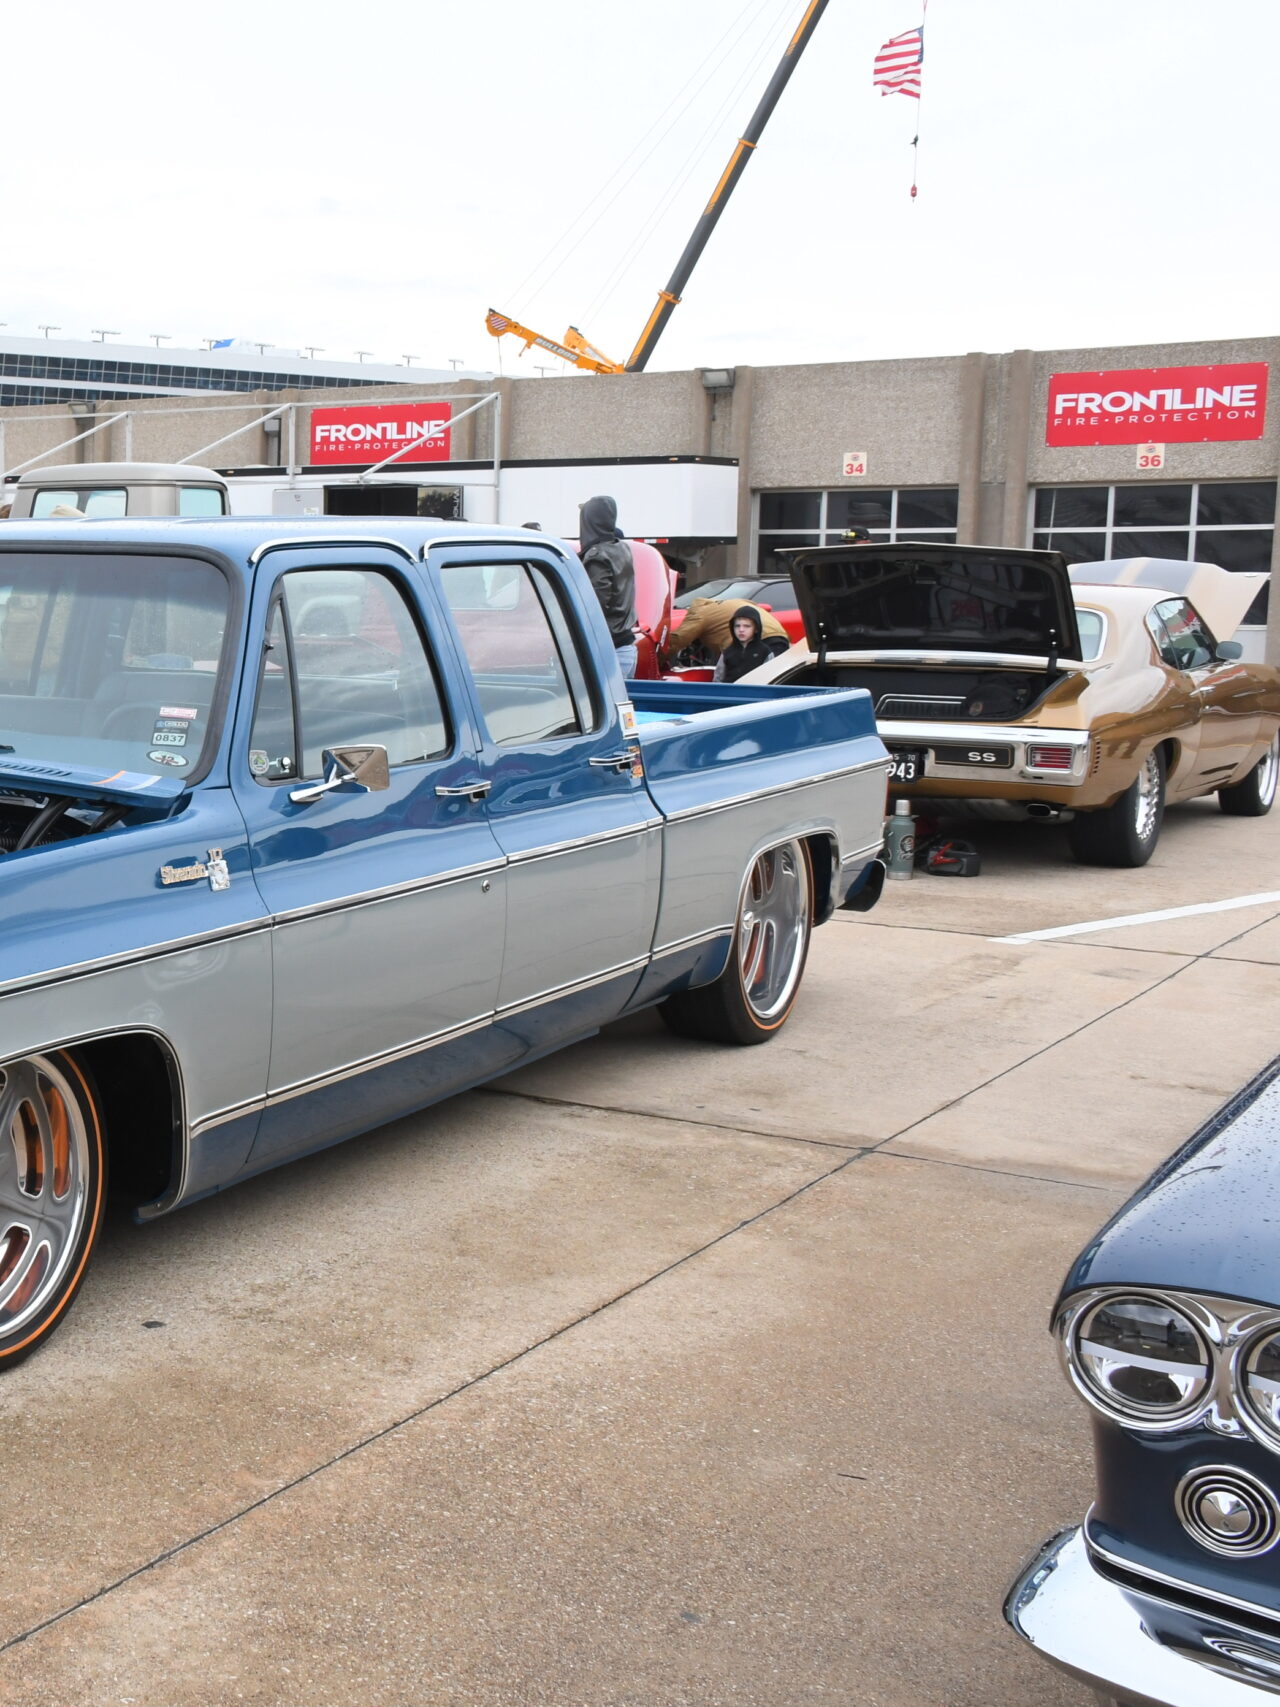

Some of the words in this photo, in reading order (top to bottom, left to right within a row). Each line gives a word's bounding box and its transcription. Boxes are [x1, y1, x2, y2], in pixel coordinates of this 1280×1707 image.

[1055, 384, 1258, 415] FRONTLINE
[1115, 410, 1256, 424] PROTECTION
[315, 420, 445, 442] FRONTLINE
[355, 440, 445, 450] PROTECION
[1139, 455, 1161, 468] 36
[845, 463, 864, 475] 34
[155, 734, 185, 743] 0837
[967, 751, 997, 762] SS
